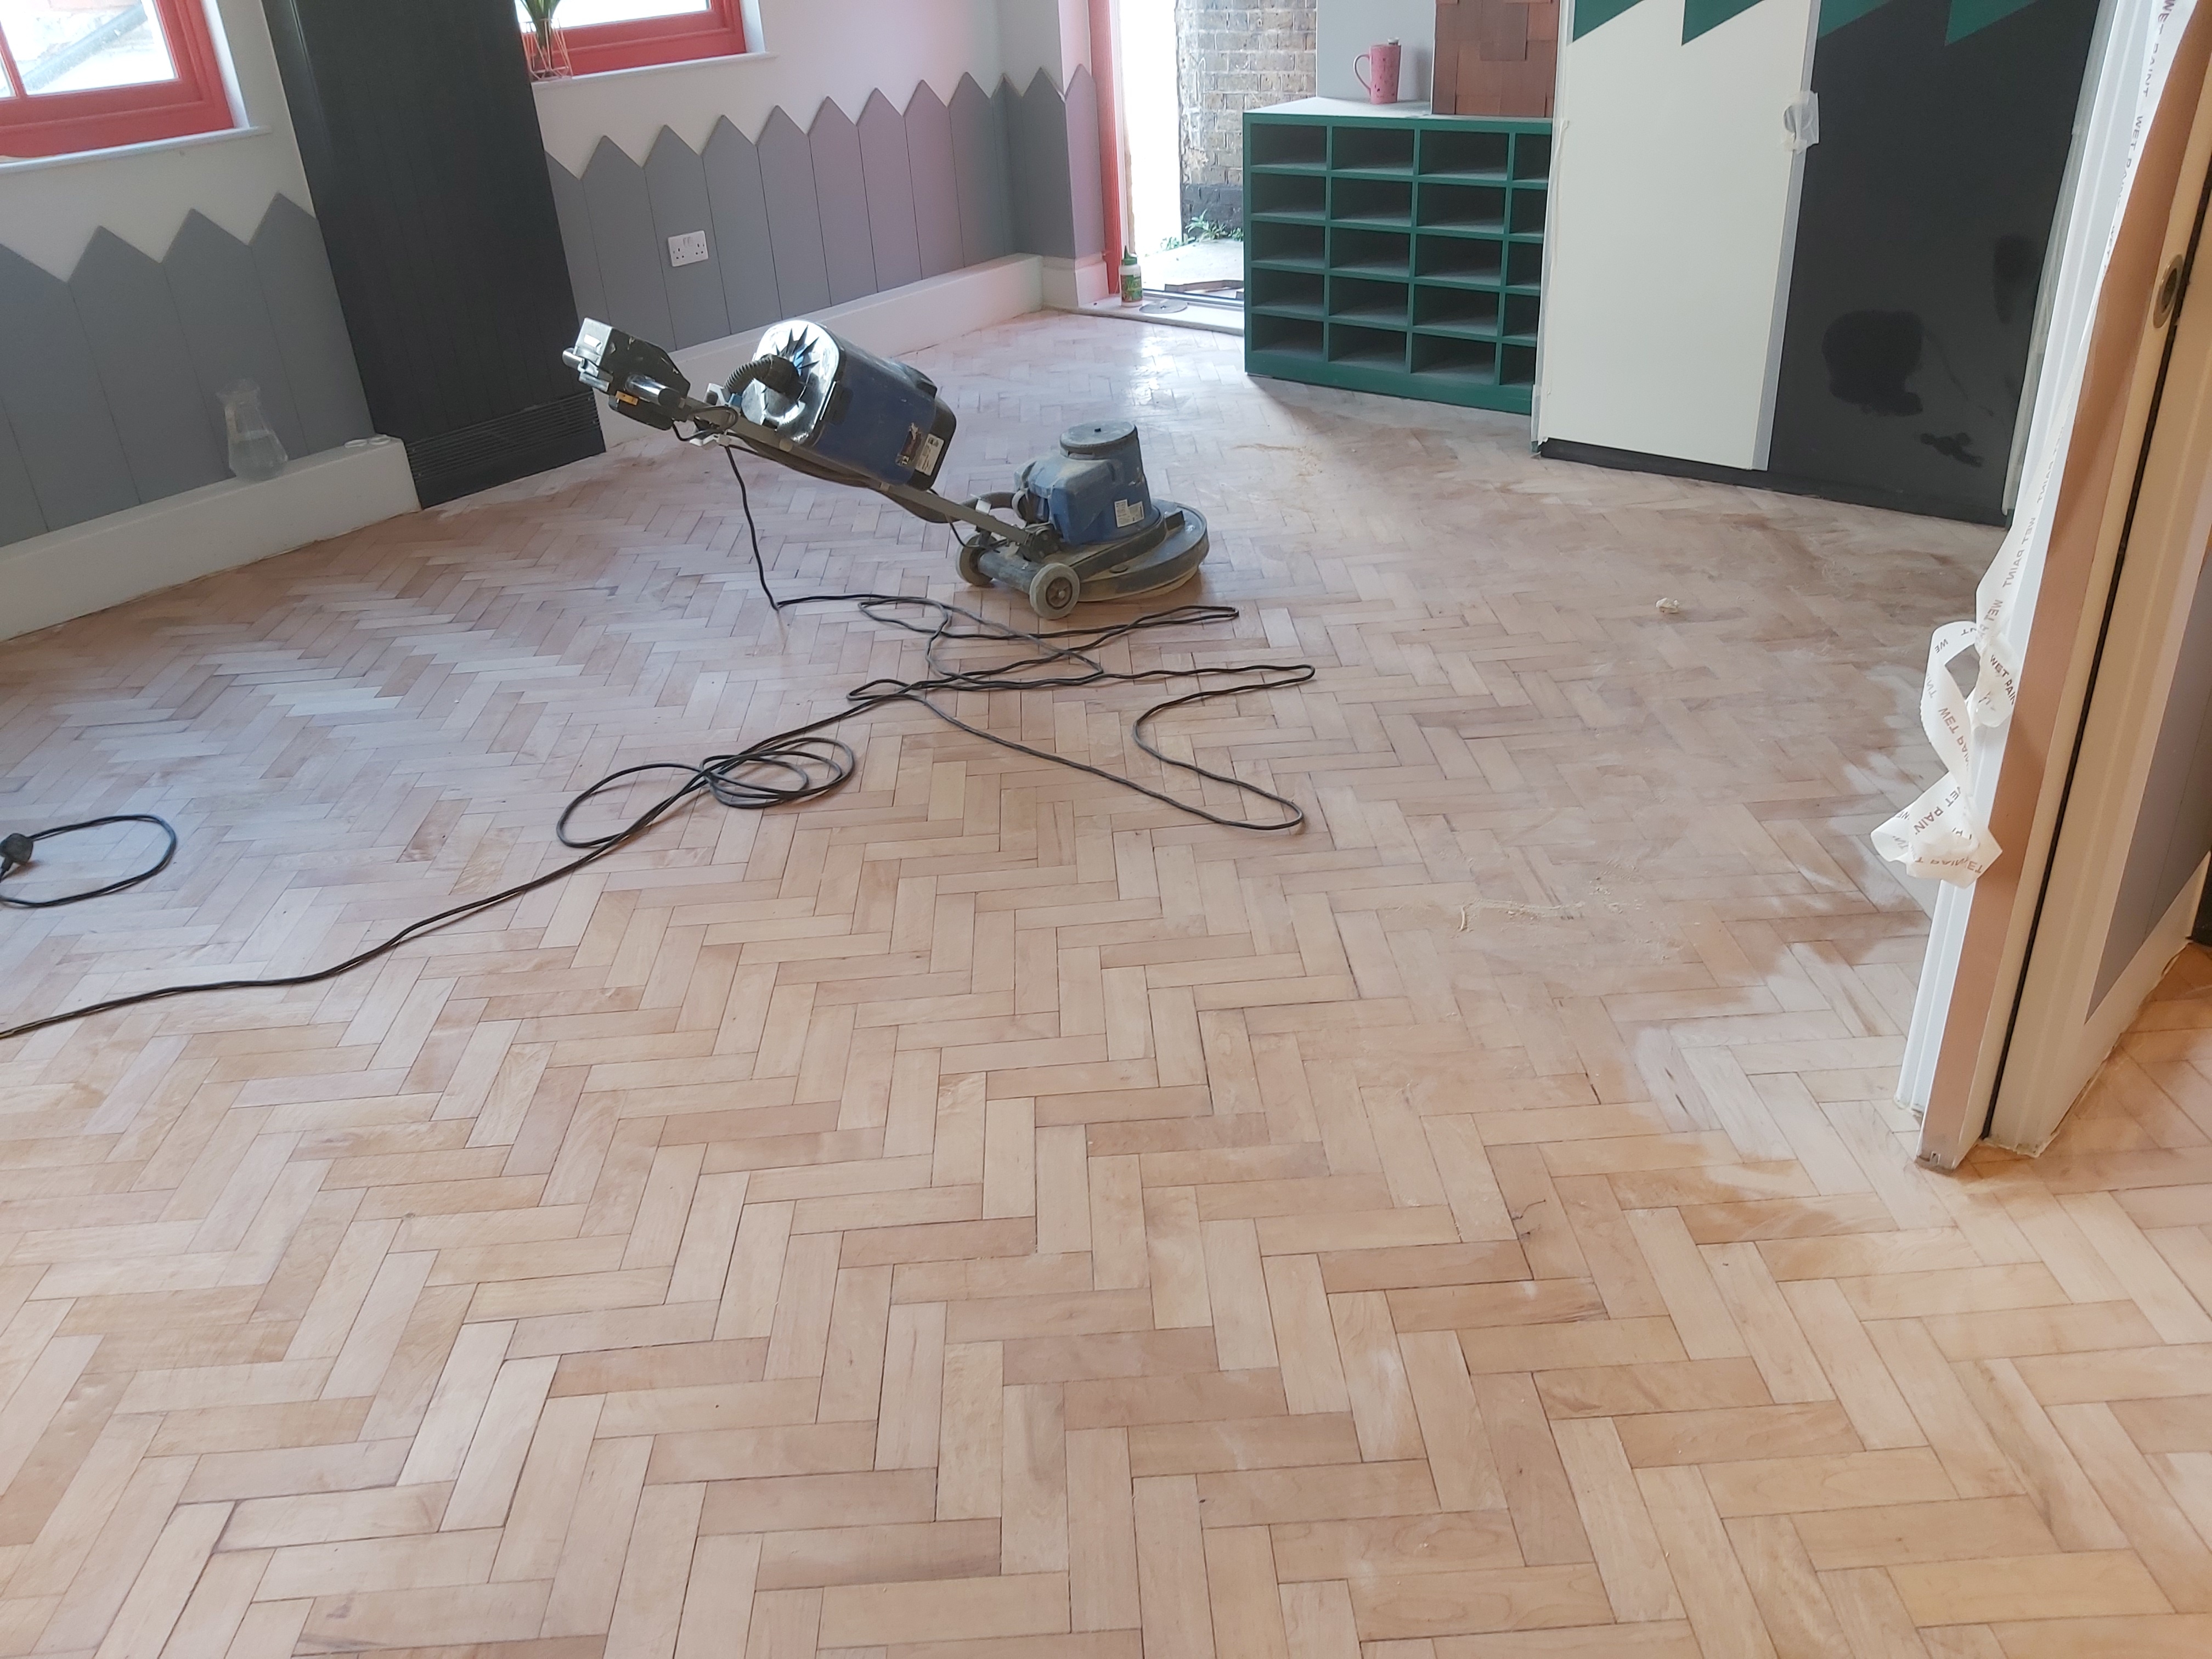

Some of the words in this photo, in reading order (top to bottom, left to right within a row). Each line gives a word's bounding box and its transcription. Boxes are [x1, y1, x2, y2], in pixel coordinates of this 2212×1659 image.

[2130, 115, 2143, 151] WET
[1989, 654, 2010, 678] WET
[2004, 679, 2017, 706] PAIN
[1914, 806, 1944, 835] PAIN
